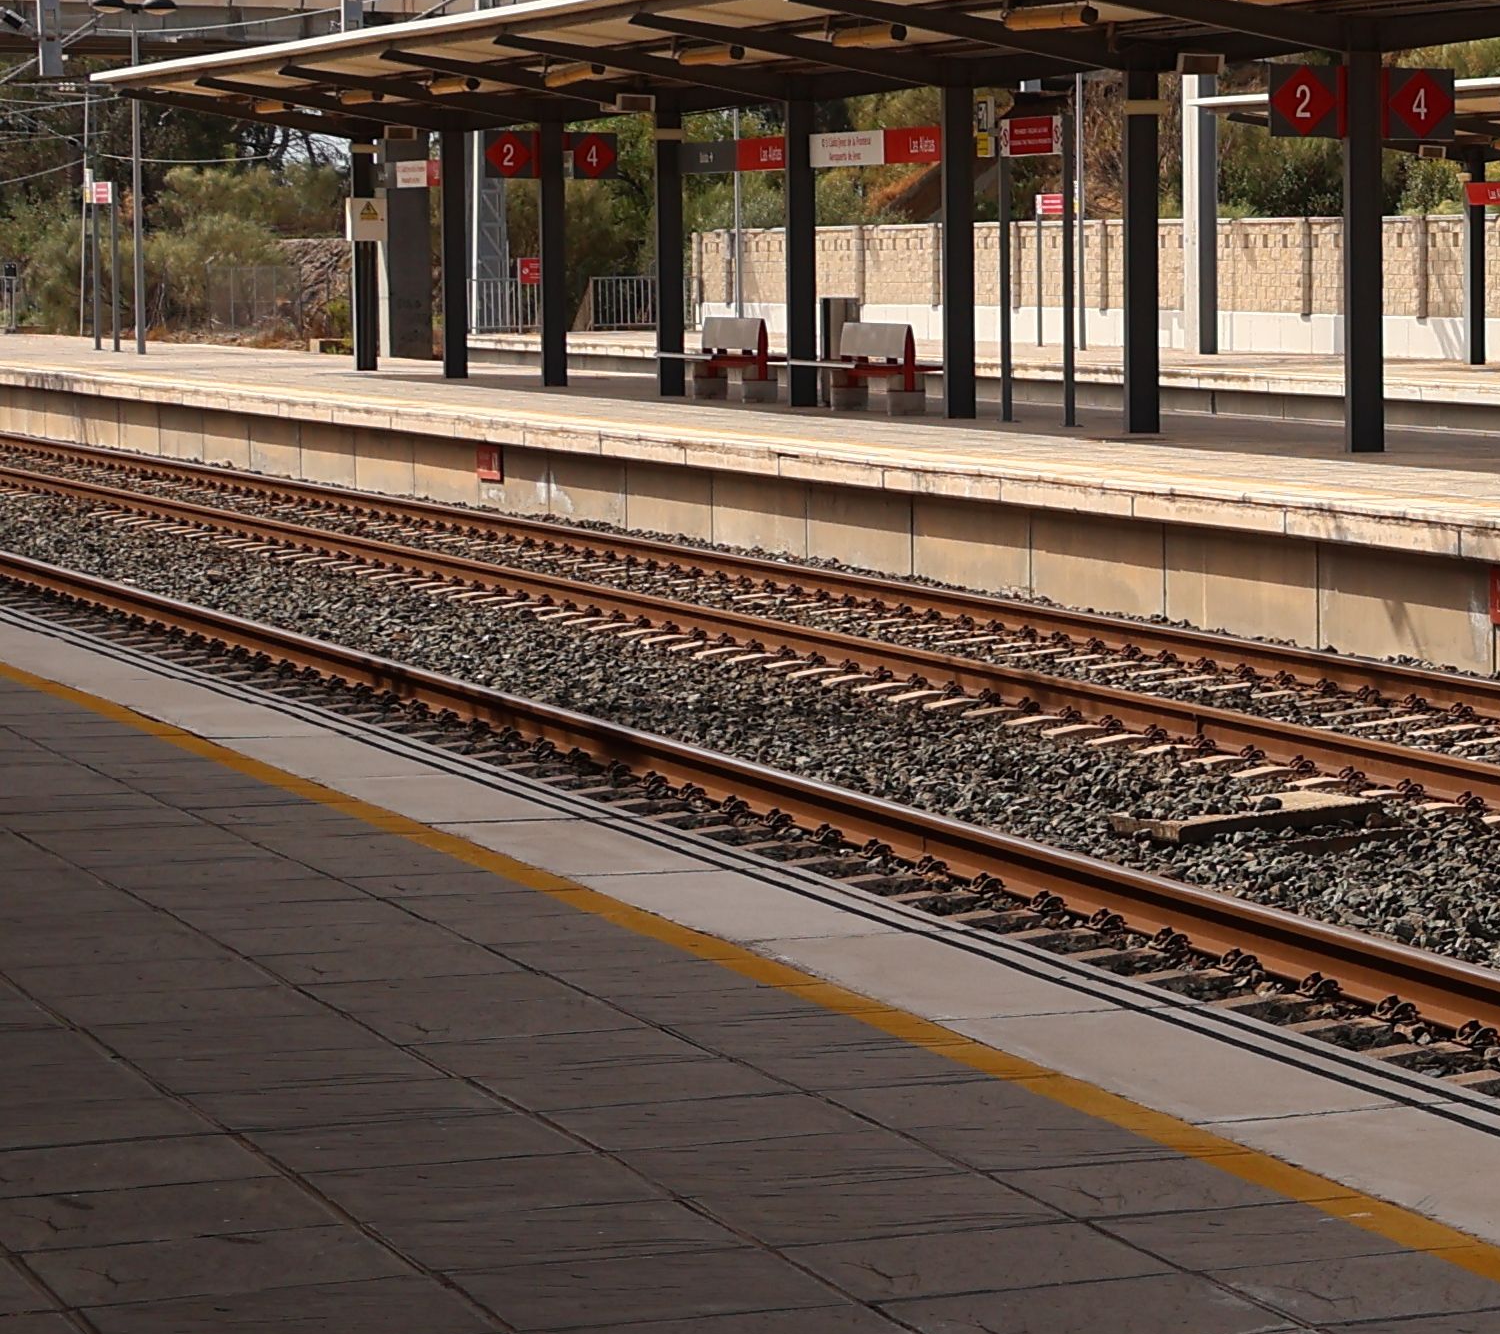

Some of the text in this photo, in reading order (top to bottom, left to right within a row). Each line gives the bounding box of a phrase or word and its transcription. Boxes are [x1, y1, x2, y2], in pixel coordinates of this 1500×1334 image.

[1295, 84, 1311, 118] 2
[1412, 88, 1428, 120] 4
[502, 143, 514, 166] 2
[586, 145, 598, 166] 4
